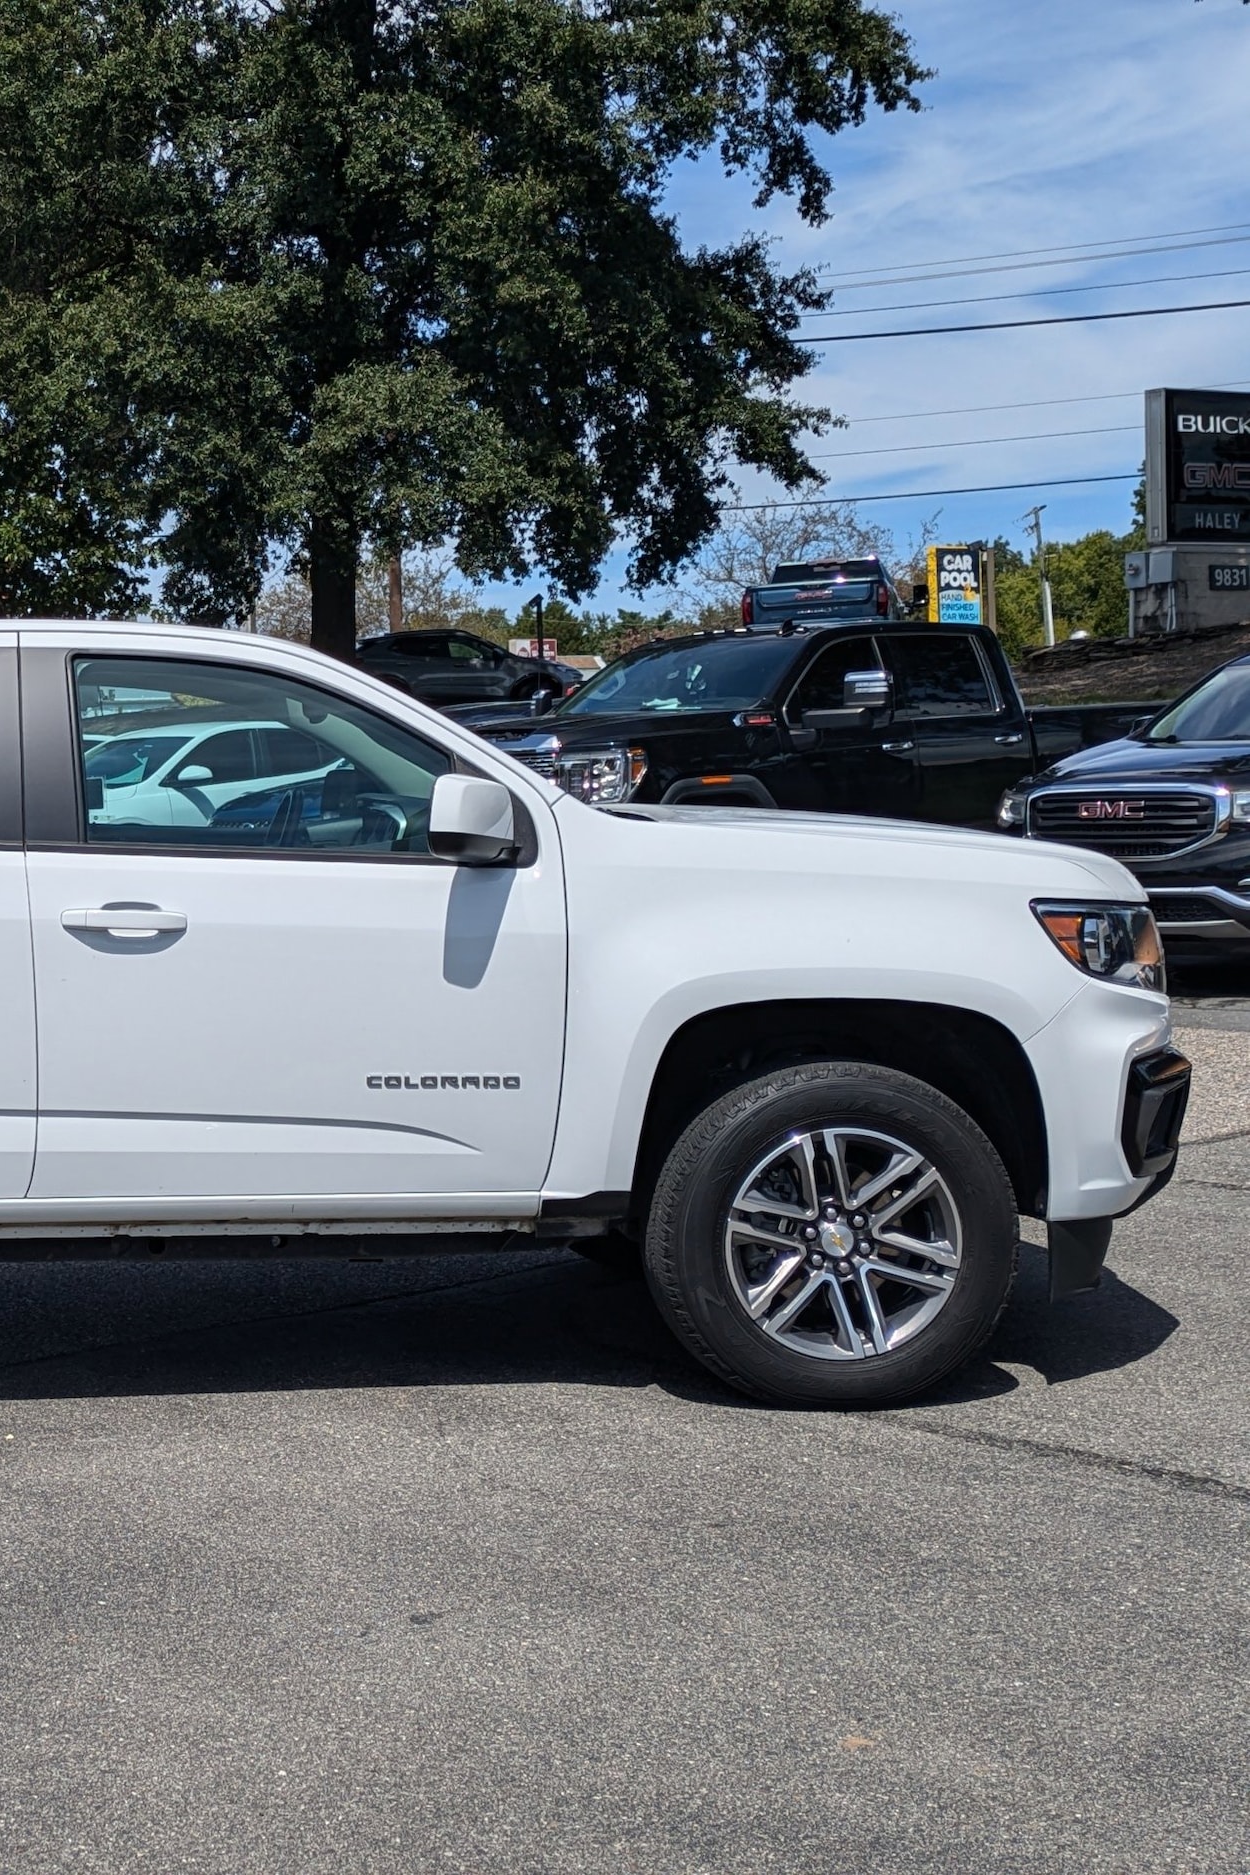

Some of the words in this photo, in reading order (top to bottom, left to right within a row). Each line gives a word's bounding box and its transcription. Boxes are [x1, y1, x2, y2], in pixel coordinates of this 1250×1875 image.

[1177, 415, 1250, 434] BUICK
[1184, 463, 1250, 488] GMC
[1195, 513, 1241, 529] HALEY
[943, 554, 972, 571] CAR
[940, 571, 978, 588] POOL
[1215, 569, 1248, 586] 9831
[941, 594, 962, 602] HAND
[941, 603, 974, 612] FINISHED
[942, 613, 957, 621] CAR
[958, 612, 978, 621] WASH
[1078, 800, 1145, 819] GMC
[366, 1074, 521, 1090] COLORADO
